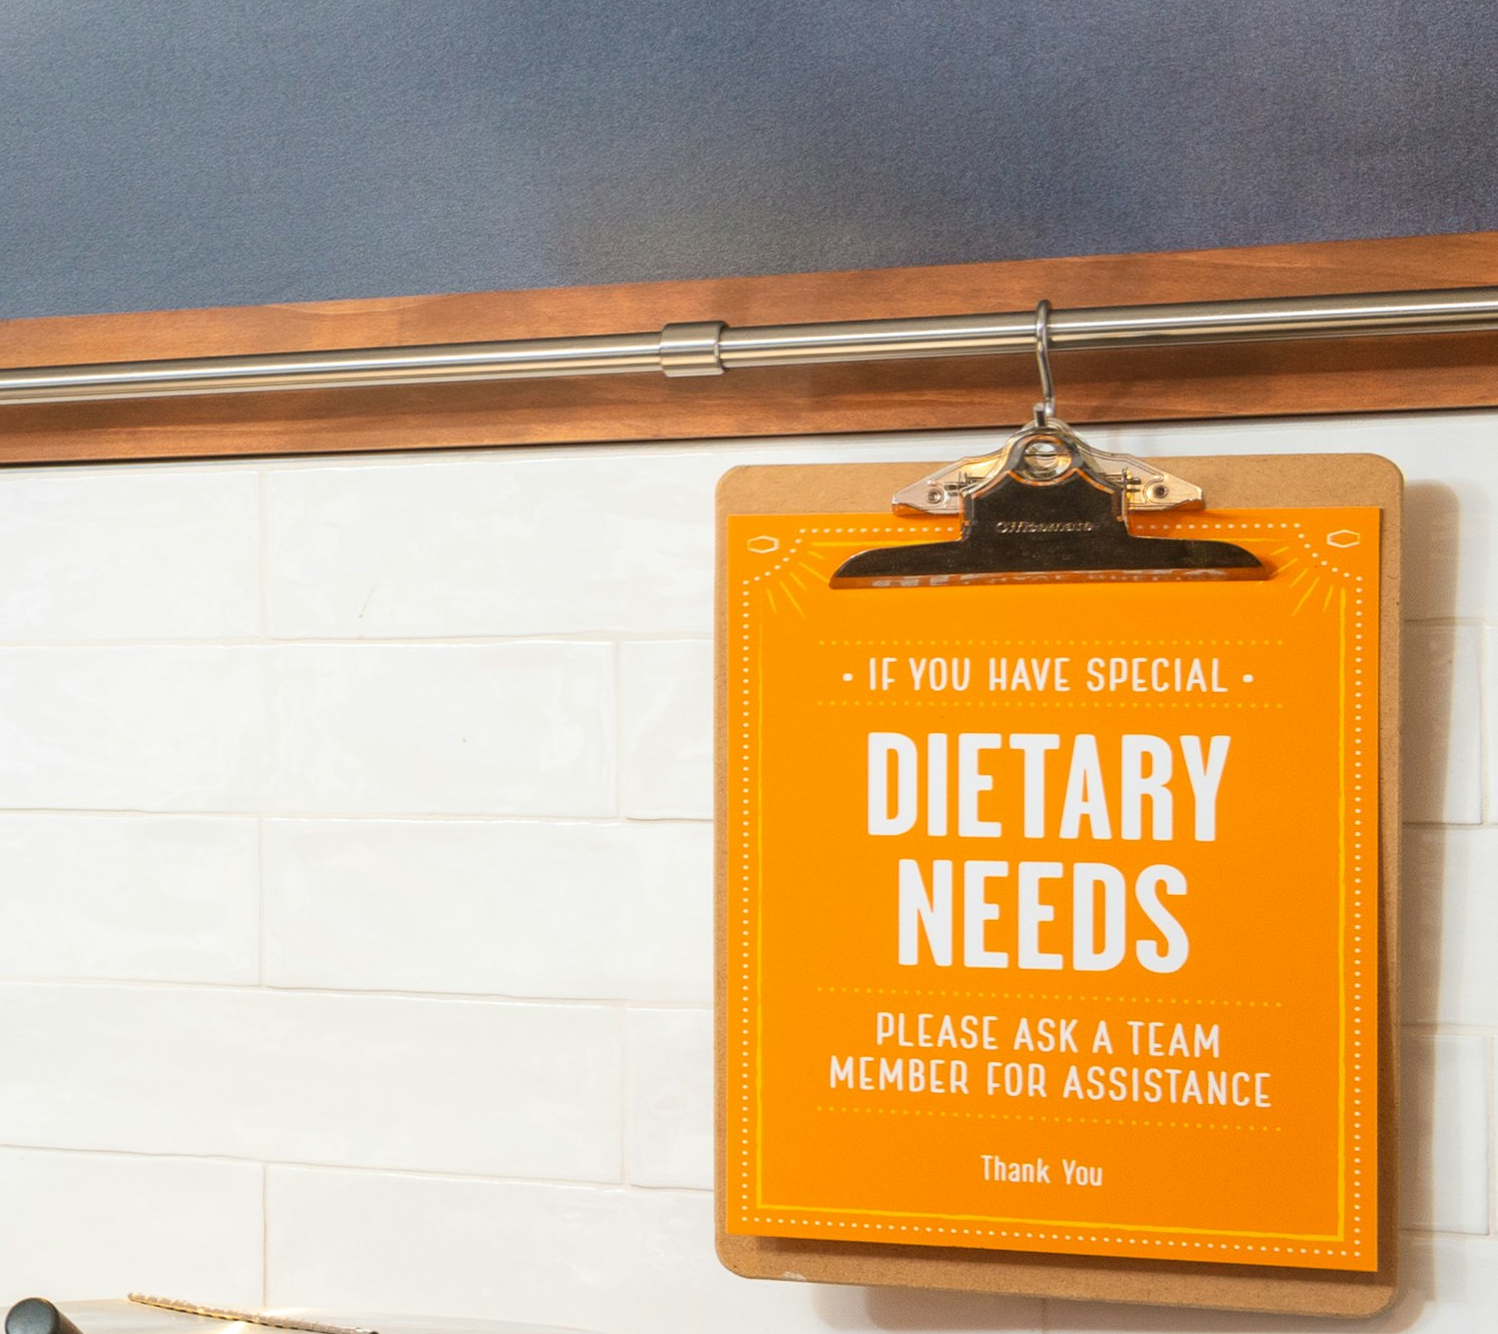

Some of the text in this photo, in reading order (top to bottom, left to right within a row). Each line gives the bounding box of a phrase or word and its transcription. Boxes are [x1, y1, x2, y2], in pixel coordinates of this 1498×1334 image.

[868, 657, 1228, 693] IF YOU HAVE SPECIAL
[867, 731, 1232, 842] DIETARY
[898, 859, 1191, 974] NEEDS
[875, 1011, 1220, 1058] PLEASE ASK A TEAM
[829, 1055, 1272, 1108] MEMBER FOR ASSISTANCE
[981, 1155, 1103, 1187] Thank You
